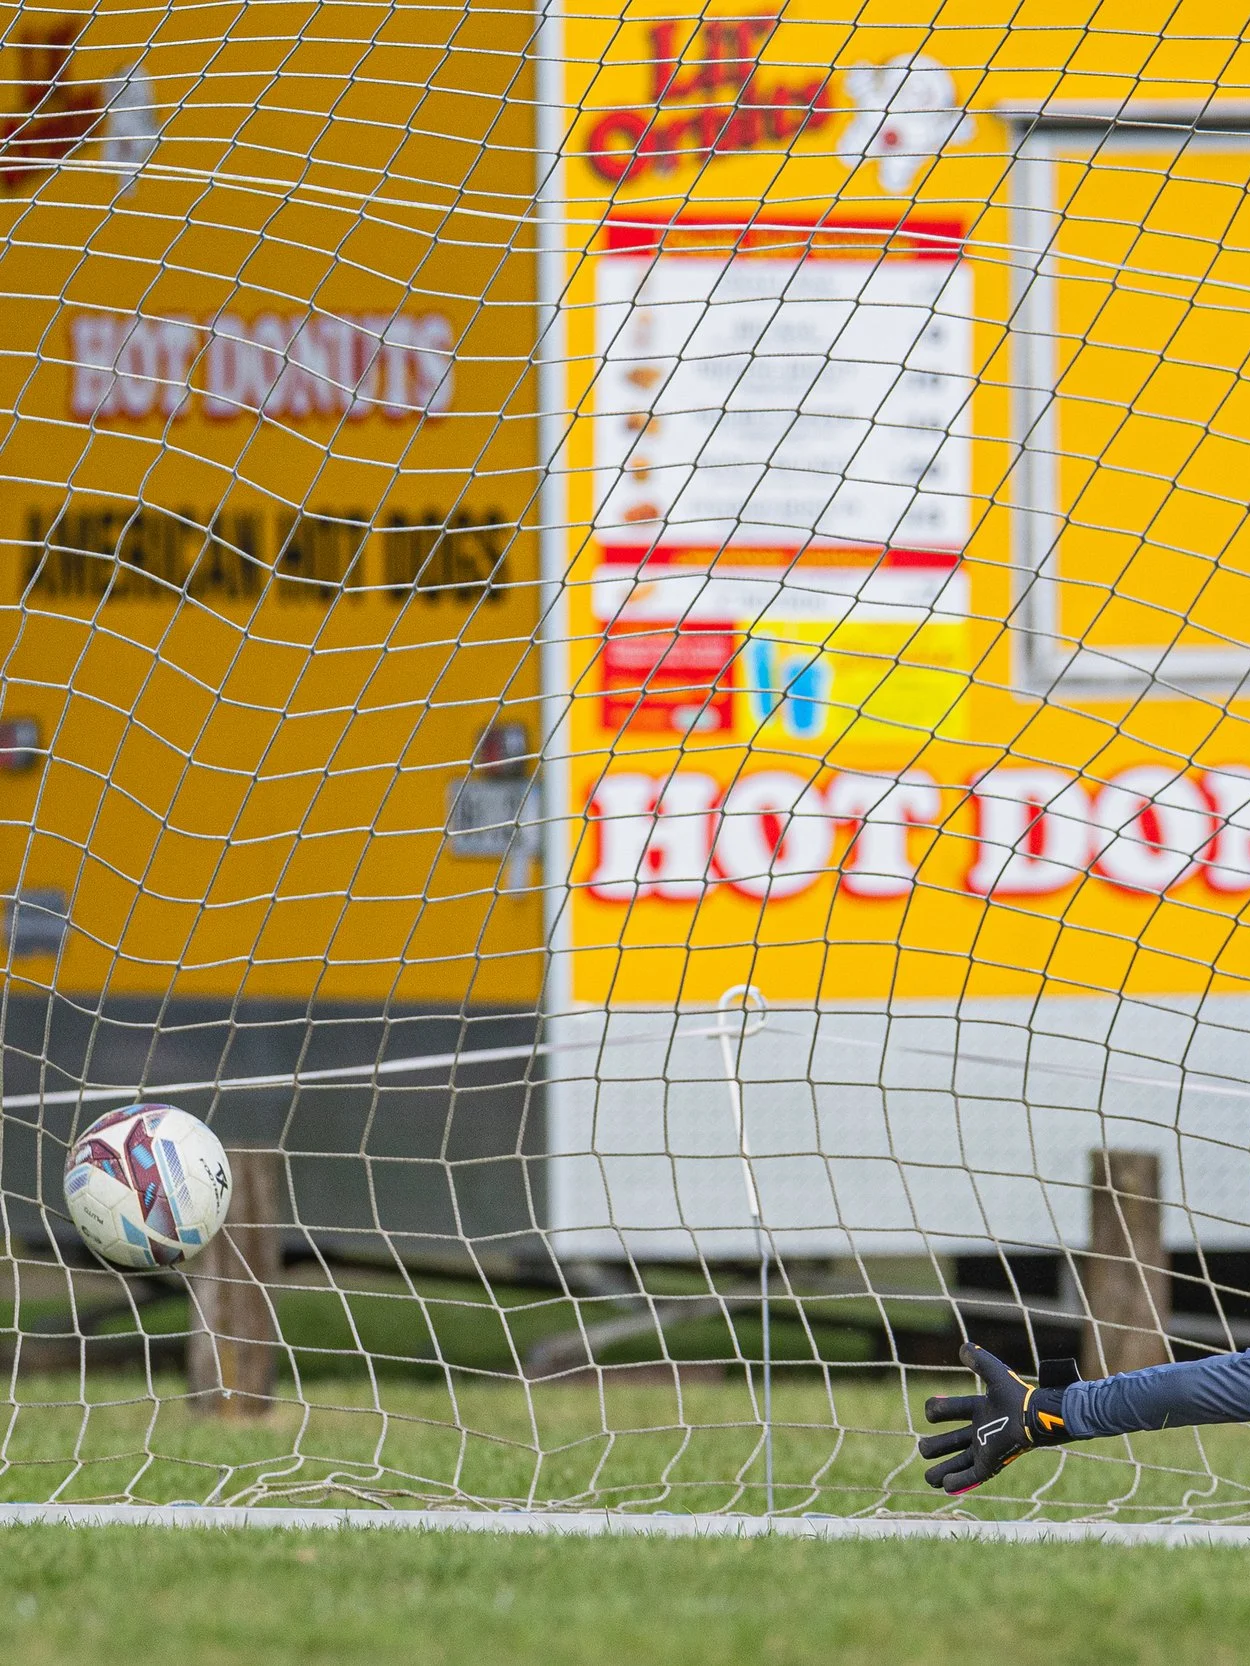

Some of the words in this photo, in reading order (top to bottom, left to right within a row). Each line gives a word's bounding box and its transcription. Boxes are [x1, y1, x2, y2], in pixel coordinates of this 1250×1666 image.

[70, 315, 196, 418] HOT
[204, 312, 456, 422] DONUTS
[588, 770, 940, 900] HOT
